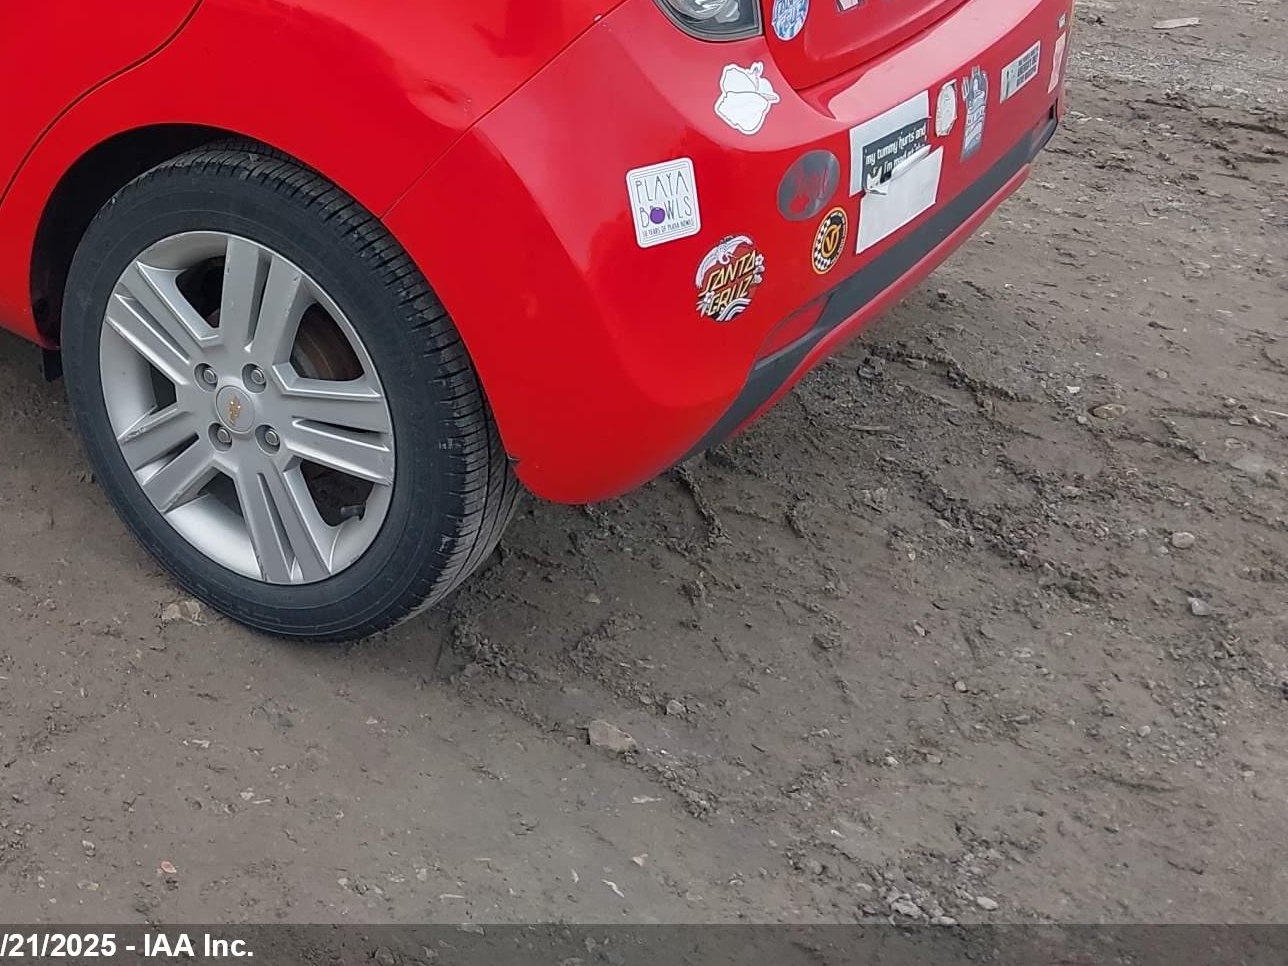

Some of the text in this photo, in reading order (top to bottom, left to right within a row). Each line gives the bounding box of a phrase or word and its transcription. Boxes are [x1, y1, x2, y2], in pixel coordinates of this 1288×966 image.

[865, 151, 876, 166] my
[876, 140, 898, 160] tummy
[899, 133, 914, 149] hurts
[915, 122, 927, 139] and
[635, 170, 689, 204] PLAYA
[639, 195, 692, 228] BOWLS
[698, 250, 756, 297] SANTA
[707, 274, 753, 316] CRUZ
